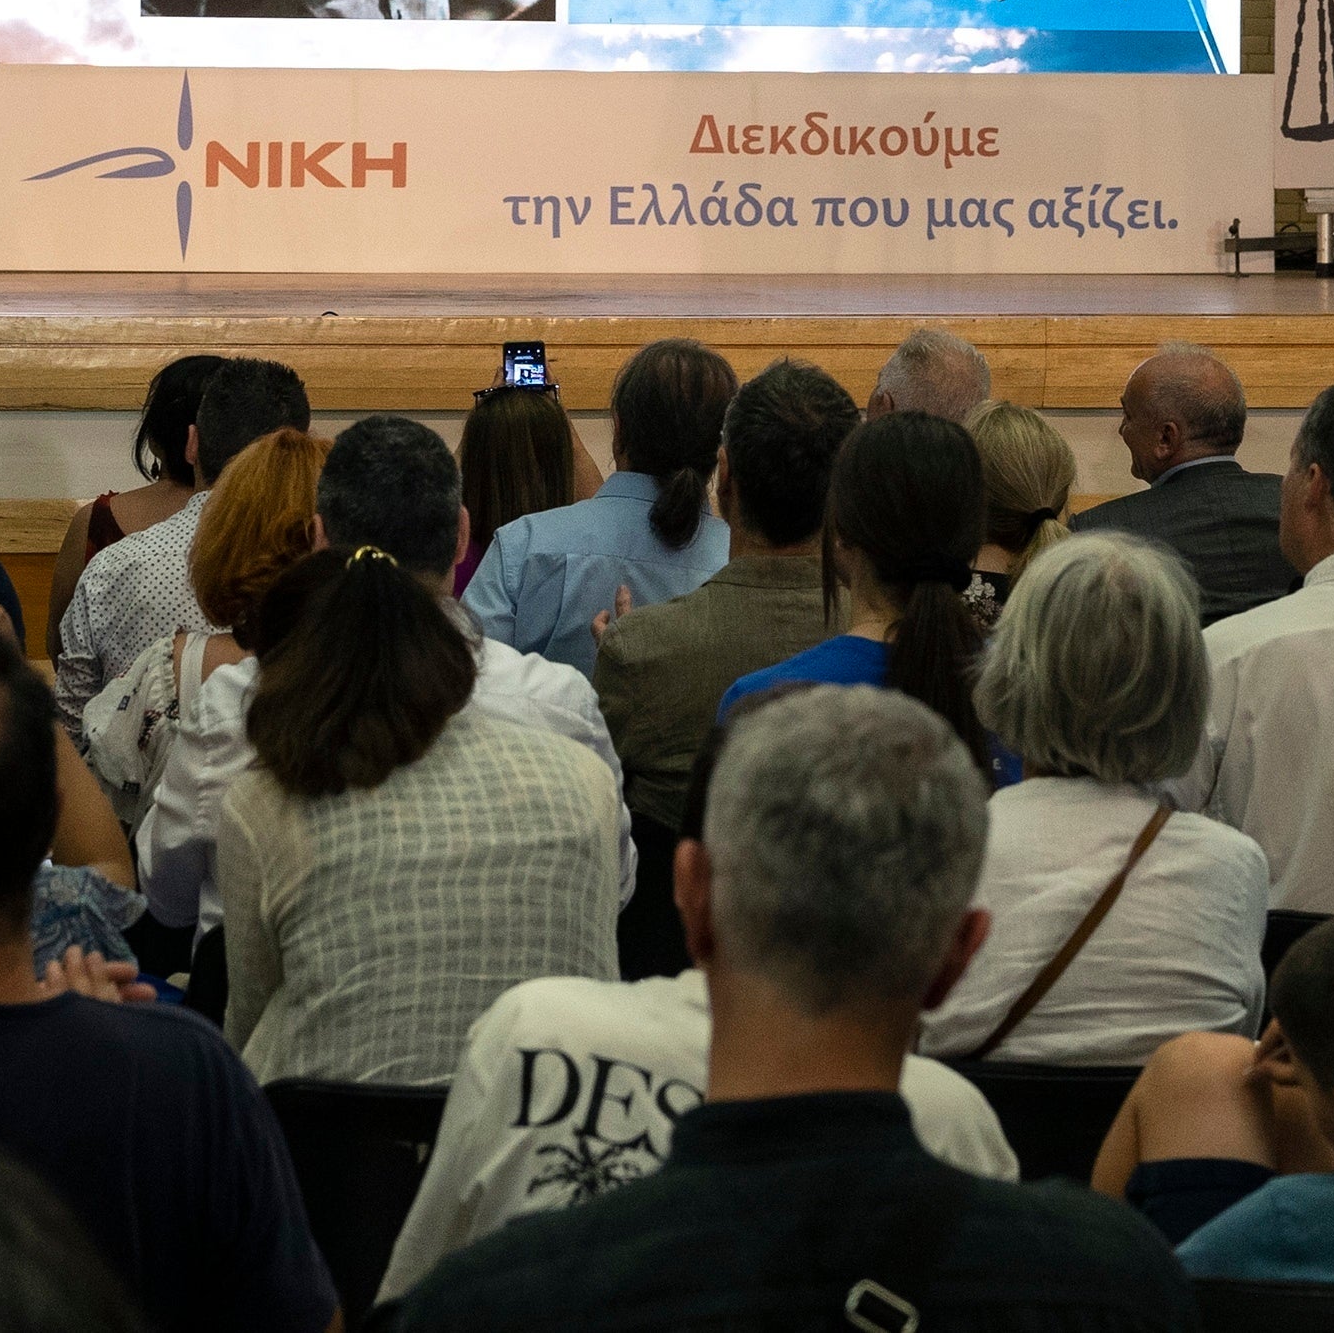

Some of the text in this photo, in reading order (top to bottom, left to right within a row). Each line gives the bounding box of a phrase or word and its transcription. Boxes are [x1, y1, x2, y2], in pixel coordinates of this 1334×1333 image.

[205, 140, 407, 189] ΝΙΚΗ
[689, 111, 1001, 169] Διεκδικούμε
[503, 180, 1180, 240] την Ελλάδα που μας αξίζει.
